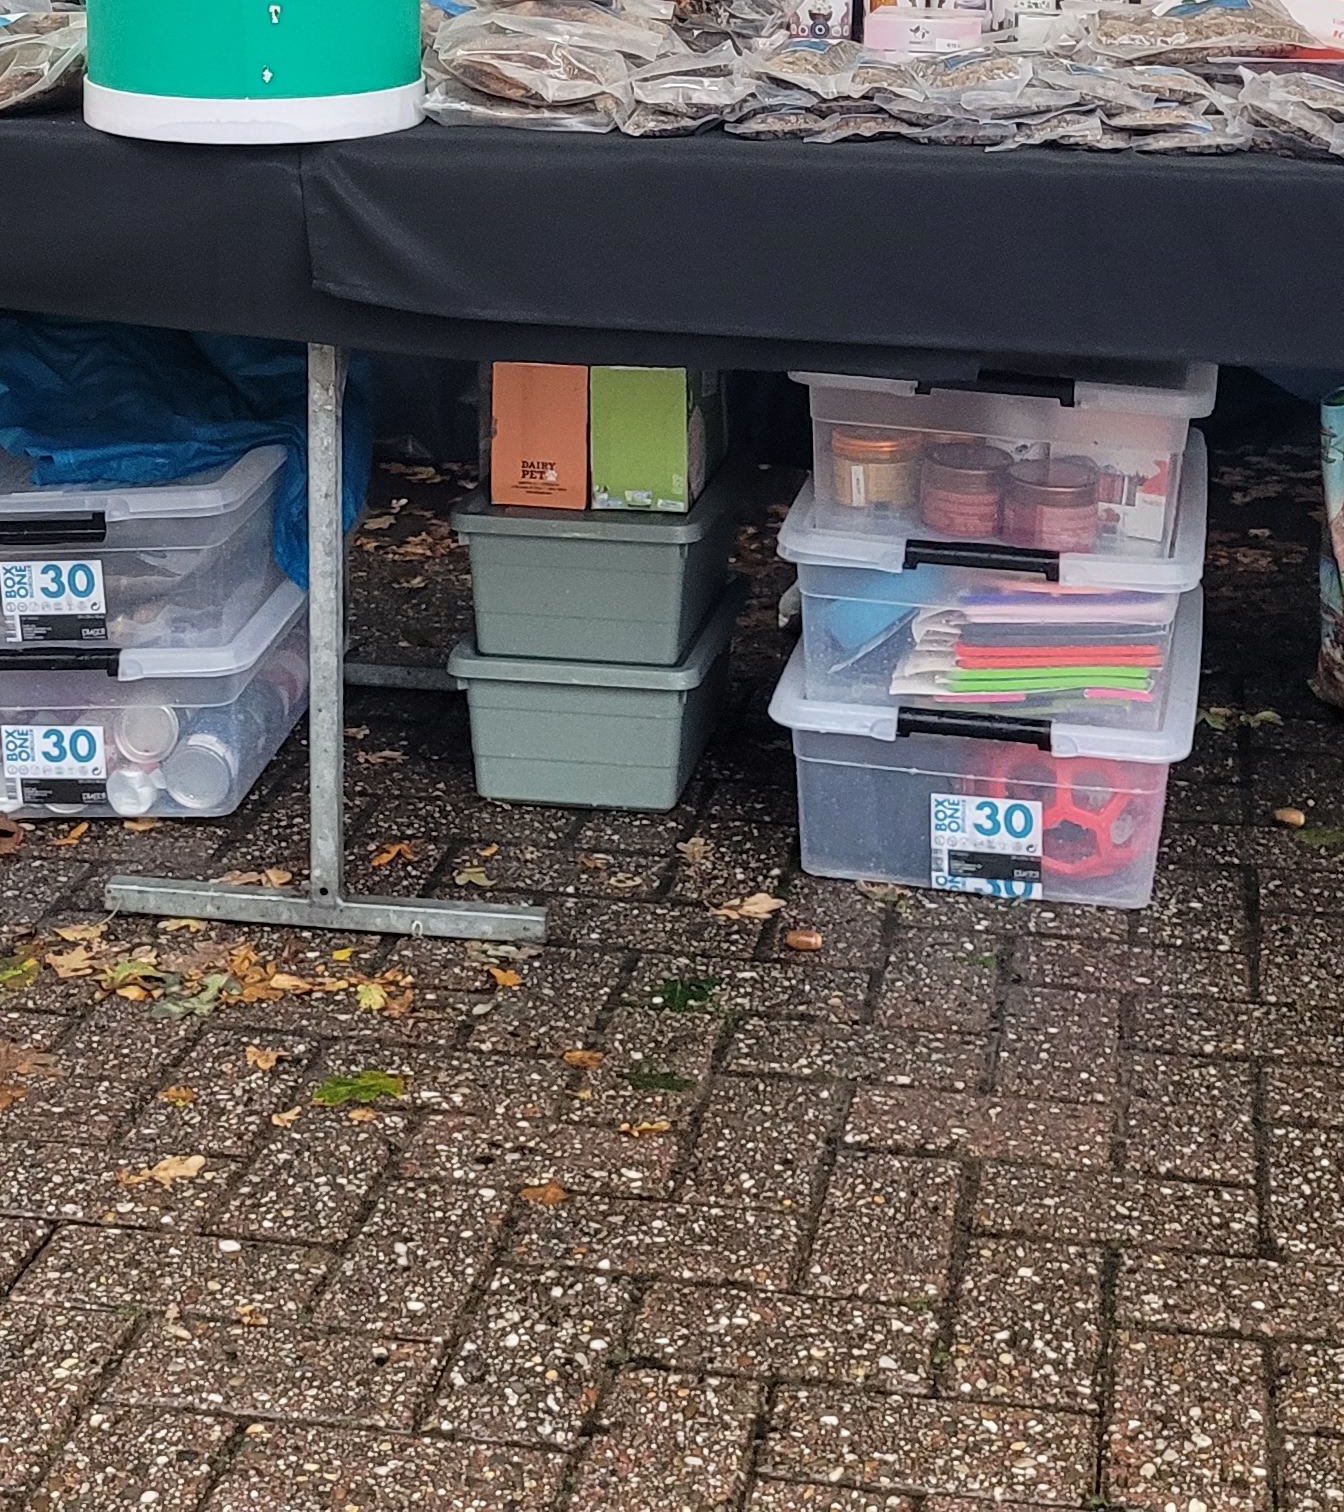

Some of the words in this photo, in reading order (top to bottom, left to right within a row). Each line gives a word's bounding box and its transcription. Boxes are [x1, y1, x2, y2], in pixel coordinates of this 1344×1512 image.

[521, 460, 556, 471] DAIRY
[521, 470, 546, 480] PET
[2, 565, 16, 599] BOX
[16, 565, 29, 599] ONE
[40, 563, 95, 599] 30
[5, 729, 18, 762] BOX
[17, 729, 30, 762] ONE
[41, 728, 97, 763] 30
[934, 798, 948, 832] BOX
[947, 798, 961, 833] ONE
[973, 800, 1034, 839] 30
